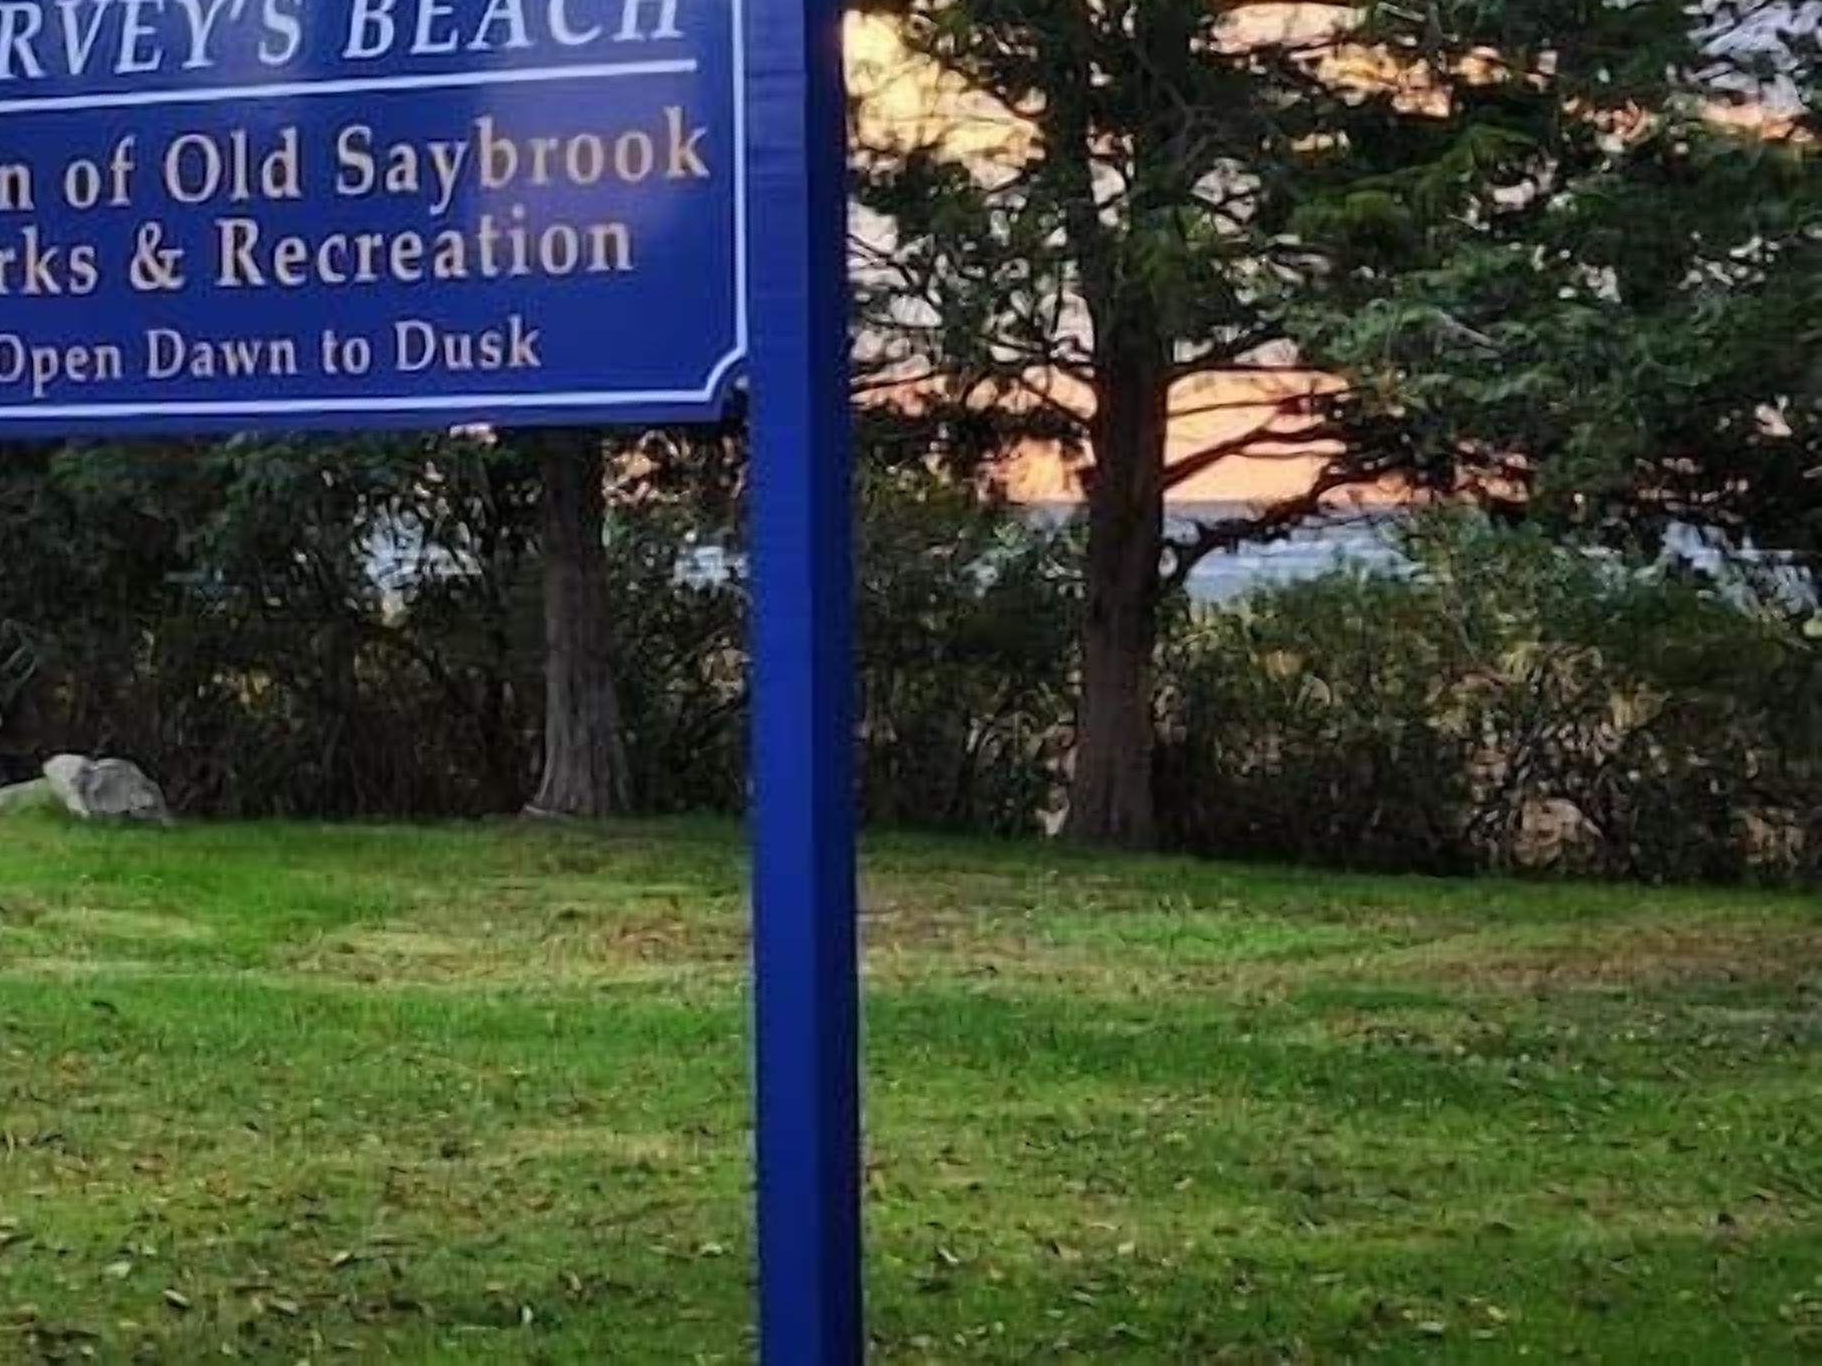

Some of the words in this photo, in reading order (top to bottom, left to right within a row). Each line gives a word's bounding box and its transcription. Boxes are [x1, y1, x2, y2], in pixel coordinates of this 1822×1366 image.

[64, 135, 134, 209] of
[163, 126, 301, 203] Old
[336, 106, 709, 218] Saybrook
[130, 222, 185, 290] &
[215, 206, 633, 286] Recreation
[146, 328, 297, 378] Dawn
[322, 330, 370, 374] to
[394, 315, 541, 371] Dusk
